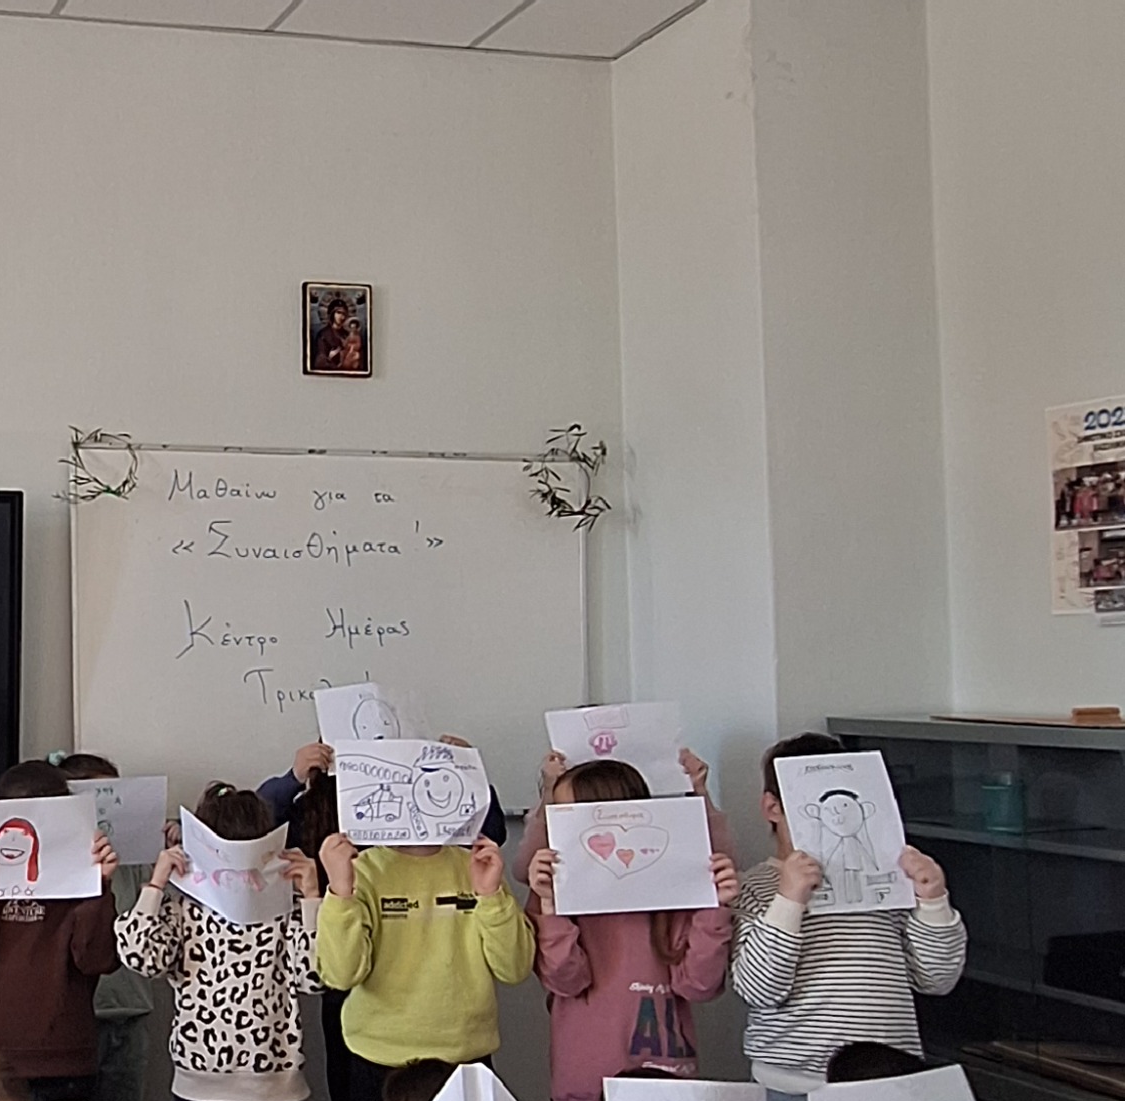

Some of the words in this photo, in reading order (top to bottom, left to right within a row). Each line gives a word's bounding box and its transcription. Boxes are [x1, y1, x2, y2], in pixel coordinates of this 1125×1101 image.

[1084, 406, 1125, 430] 202
[312, 489, 347, 511] για
[374, 492, 395, 503] τα
[176, 600, 278, 659] Κέντρο
[325, 607, 410, 649] Ημέρας
